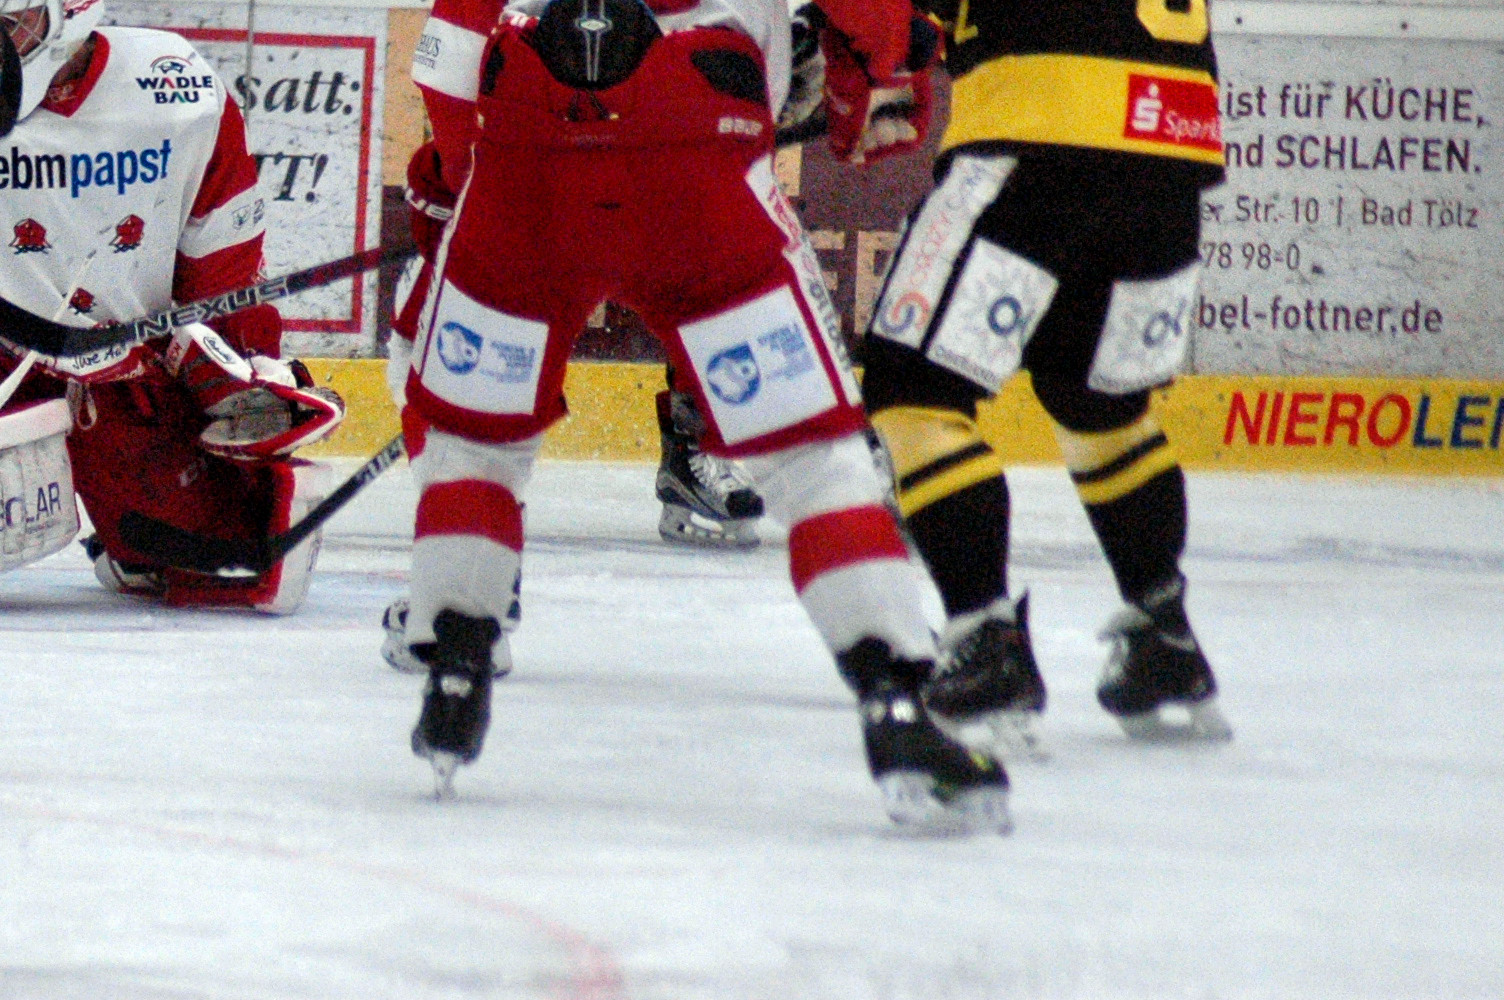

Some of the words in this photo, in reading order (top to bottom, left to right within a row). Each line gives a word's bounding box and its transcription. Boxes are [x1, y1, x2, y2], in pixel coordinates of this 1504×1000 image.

[136, 75, 213, 91] WADLE
[154, 90, 200, 105] BAU
[1220, 82, 1266, 119] ist
[1279, 83, 1334, 120] für
[1345, 77, 1486, 129] KÜCHE,
[1276, 134, 1483, 175] SCHLAFEN.
[1235, 194, 1280, 224] Str.
[1292, 196, 1320, 225] 10
[1361, 199, 1413, 227] Bad
[1422, 198, 1479, 229] Tölz
[1242, 241, 1301, 272] 98-0
[133, 277, 289, 342] NEXUS
[1198, 294, 1444, 334] bel-fottner.de
